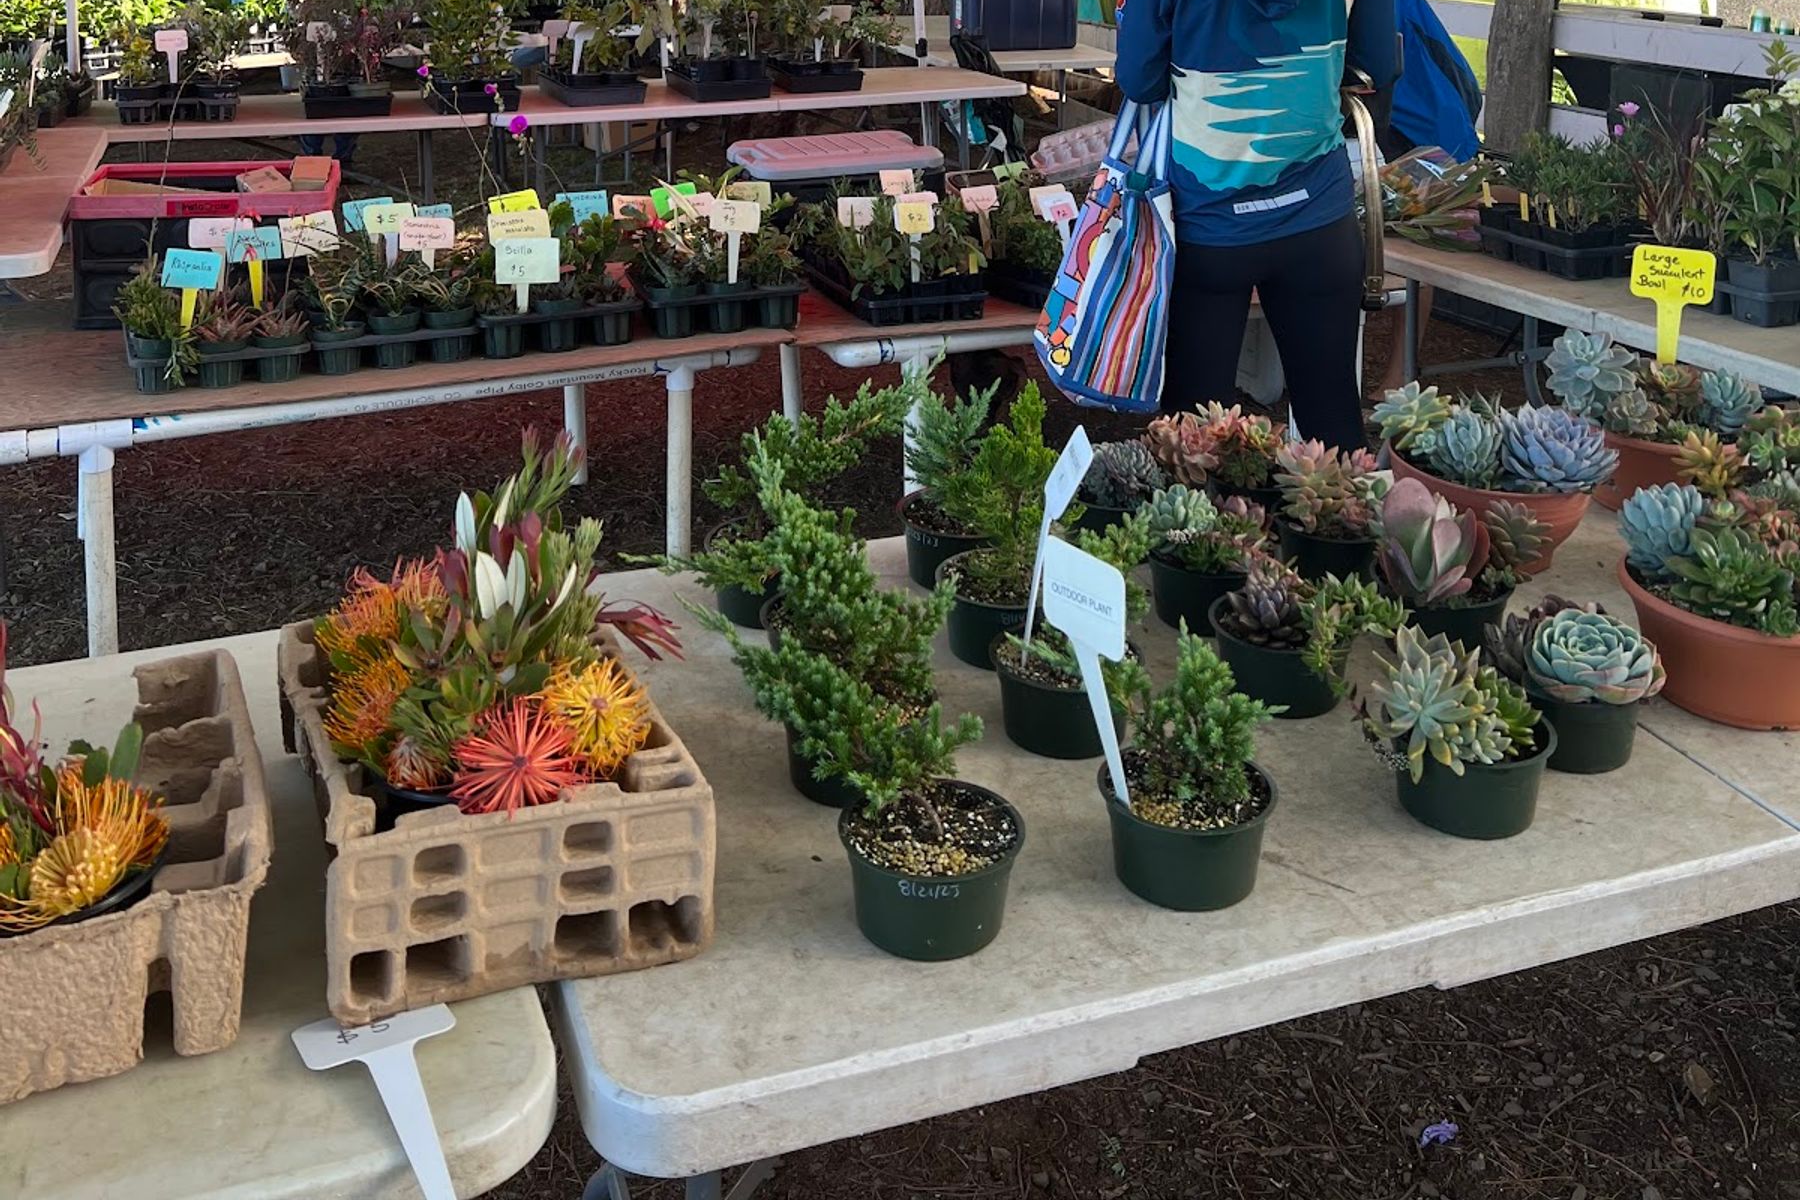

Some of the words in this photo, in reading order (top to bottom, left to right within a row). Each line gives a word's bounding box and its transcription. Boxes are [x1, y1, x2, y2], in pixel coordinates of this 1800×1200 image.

[1643, 250, 1680, 268] Large
[511, 264, 525, 277] $5
[1649, 265, 1705, 280] Succulent
[1636, 275, 1666, 290] Bowl
[1682, 282, 1705, 297] $10
[609, 367, 647, 378] Rocky
[549, 373, 605, 386] Mountain
[475, 386, 504, 395] Pipe
[508, 382, 544, 392] Colby
[354, 404, 369, 413] 40
[372, 395, 435, 411] SCHEDULE
[1051, 582, 1088, 605] OUTDOOR
[1088, 598, 1113, 616] PLANT
